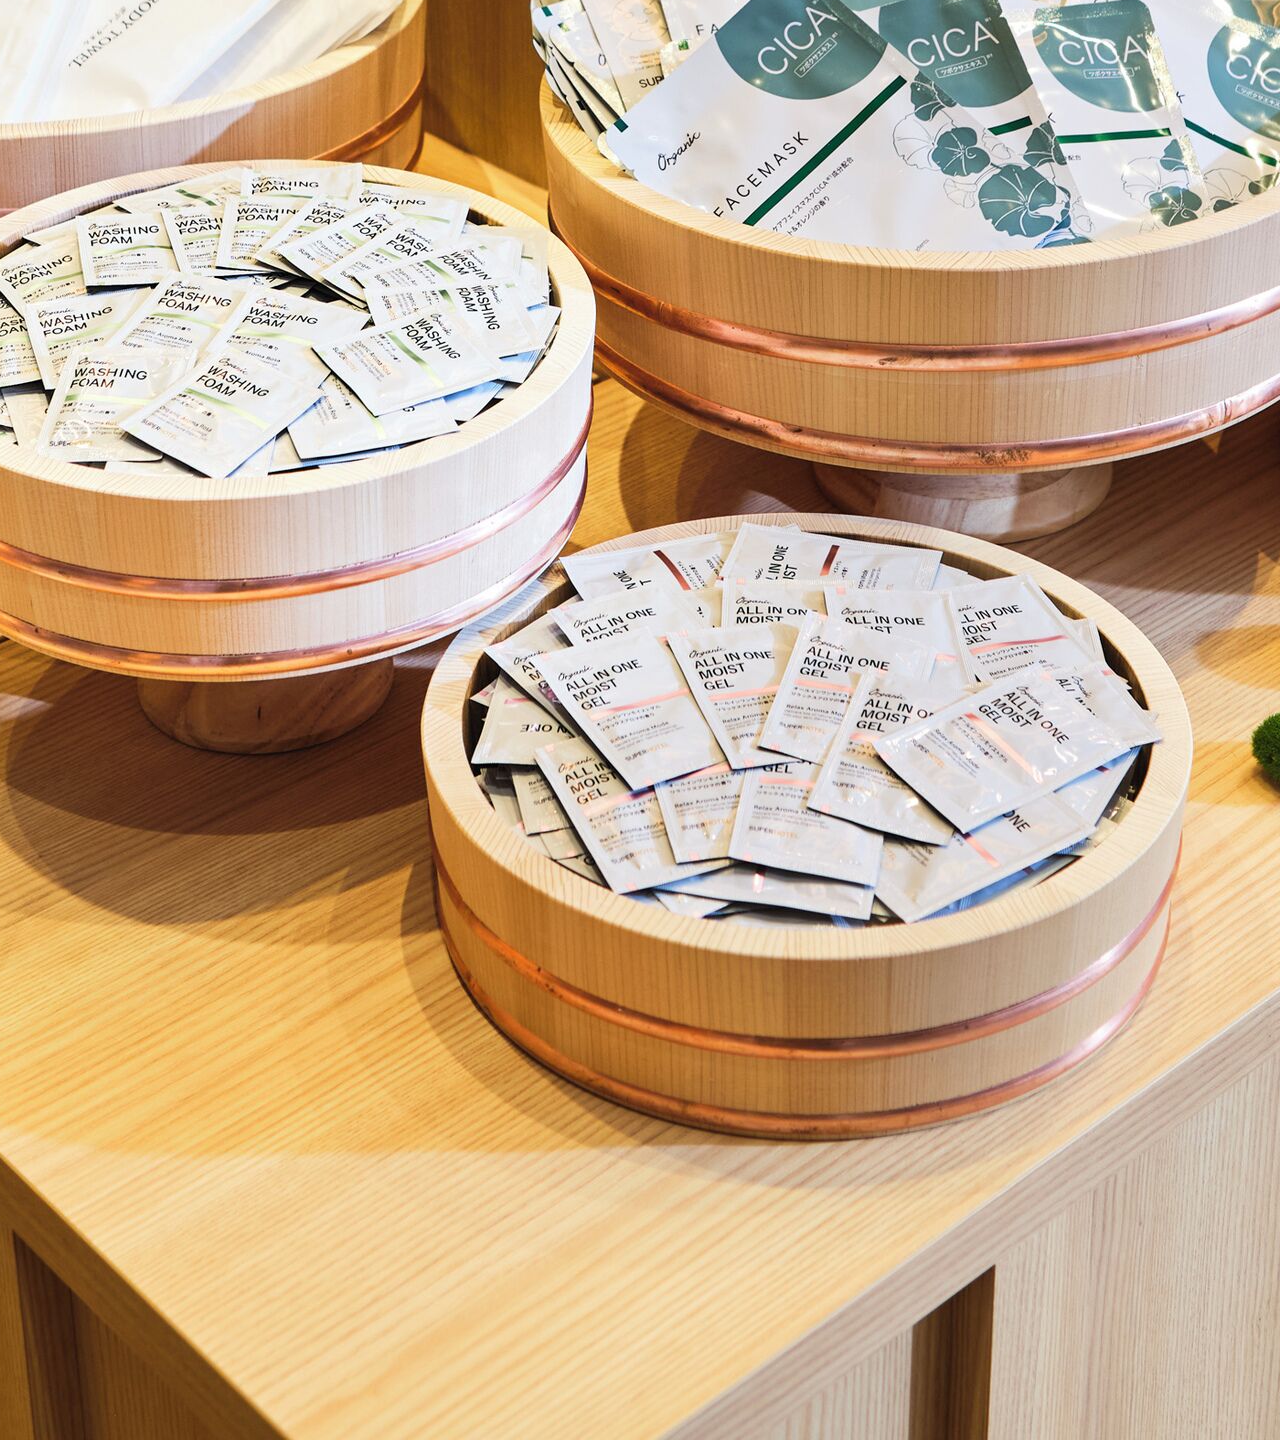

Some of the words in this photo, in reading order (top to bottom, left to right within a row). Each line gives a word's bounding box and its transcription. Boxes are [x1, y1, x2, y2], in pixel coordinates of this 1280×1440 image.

[67, 30, 123, 68] TOWEL
[757, 5, 839, 76] CICA
[907, 20, 1000, 68] CICA
[1057, 34, 1148, 67] CICA
[657, 131, 701, 172] Organic
[251, 179, 320, 189] WASHING
[713, 131, 810, 218] FACEMASK
[251, 185, 292, 195] FOAM
[358, 196, 427, 206] WASHING
[236, 213, 279, 223] FOAM
[237, 207, 299, 216] WASHIN
[88, 225, 160, 239] WASHING
[178, 224, 221, 235] FOAM
[90, 236, 133, 247] FOAM
[4, 254, 73, 284] WASHING
[437, 254, 470, 277] FOAM
[11, 269, 53, 290] FOAM
[157, 296, 201, 313] FOAM
[163, 288, 233, 308] WASHING
[455, 286, 479, 313] FOAM
[470, 284, 501, 331] WASHING
[39, 306, 114, 330] WASHING
[241, 314, 287, 329] FOAM
[248, 305, 319, 326] WASHING
[43, 321, 88, 337] FOAM
[401, 323, 433, 353] FOAM
[414, 317, 462, 360] WASHING
[69, 377, 116, 390] FOAM
[74, 367, 149, 381] WASHING
[206, 364, 270, 398] WASHING
[195, 374, 238, 398] FOAM
[735, 606, 764, 616] ALL
[767, 606, 783, 616] IN
[786, 607, 809, 617] ON
[845, 615, 872, 625] ALL
[874, 615, 890, 625] IN
[893, 616, 926, 626] ONE
[976, 610, 992, 622] IN
[992, 603, 1024, 617] ONE
[580, 624, 608, 639] ALL
[608, 615, 625, 629] IN
[625, 607, 657, 621] ONE
[694, 656, 723, 670] ALL
[725, 652, 742, 663] IN
[743, 650, 776, 661] ONE
[802, 656, 854, 674] MOIST
[806, 645, 835, 662] ALL
[837, 653, 855, 665] IN
[857, 657, 891, 672] ONE
[565, 677, 594, 693] ALL
[593, 668, 611, 683] IN
[610, 658, 643, 674] ONE
[698, 662, 746, 680] MOIST
[799, 666, 829, 680] GEL
[572, 677, 619, 703] MOIST
[703, 678, 735, 691] GEL
[580, 695, 612, 712] GEL
[864, 698, 894, 712] ALL
[897, 702, 914, 715] IN
[990, 697, 1033, 729] MOIST
[860, 709, 912, 726] MOIST
[977, 703, 1002, 725] GEL
[1003, 690, 1027, 712] ALL
[1025, 707, 1044, 722] IN
[1039, 719, 1071, 745] ONE
[855, 719, 886, 733] GEL
[564, 767, 594, 785] ALL
[594, 762, 612, 774] IN
[762, 763, 794, 775] GEL
[569, 770, 618, 795] MOIST
[575, 789, 609, 806] GEL
